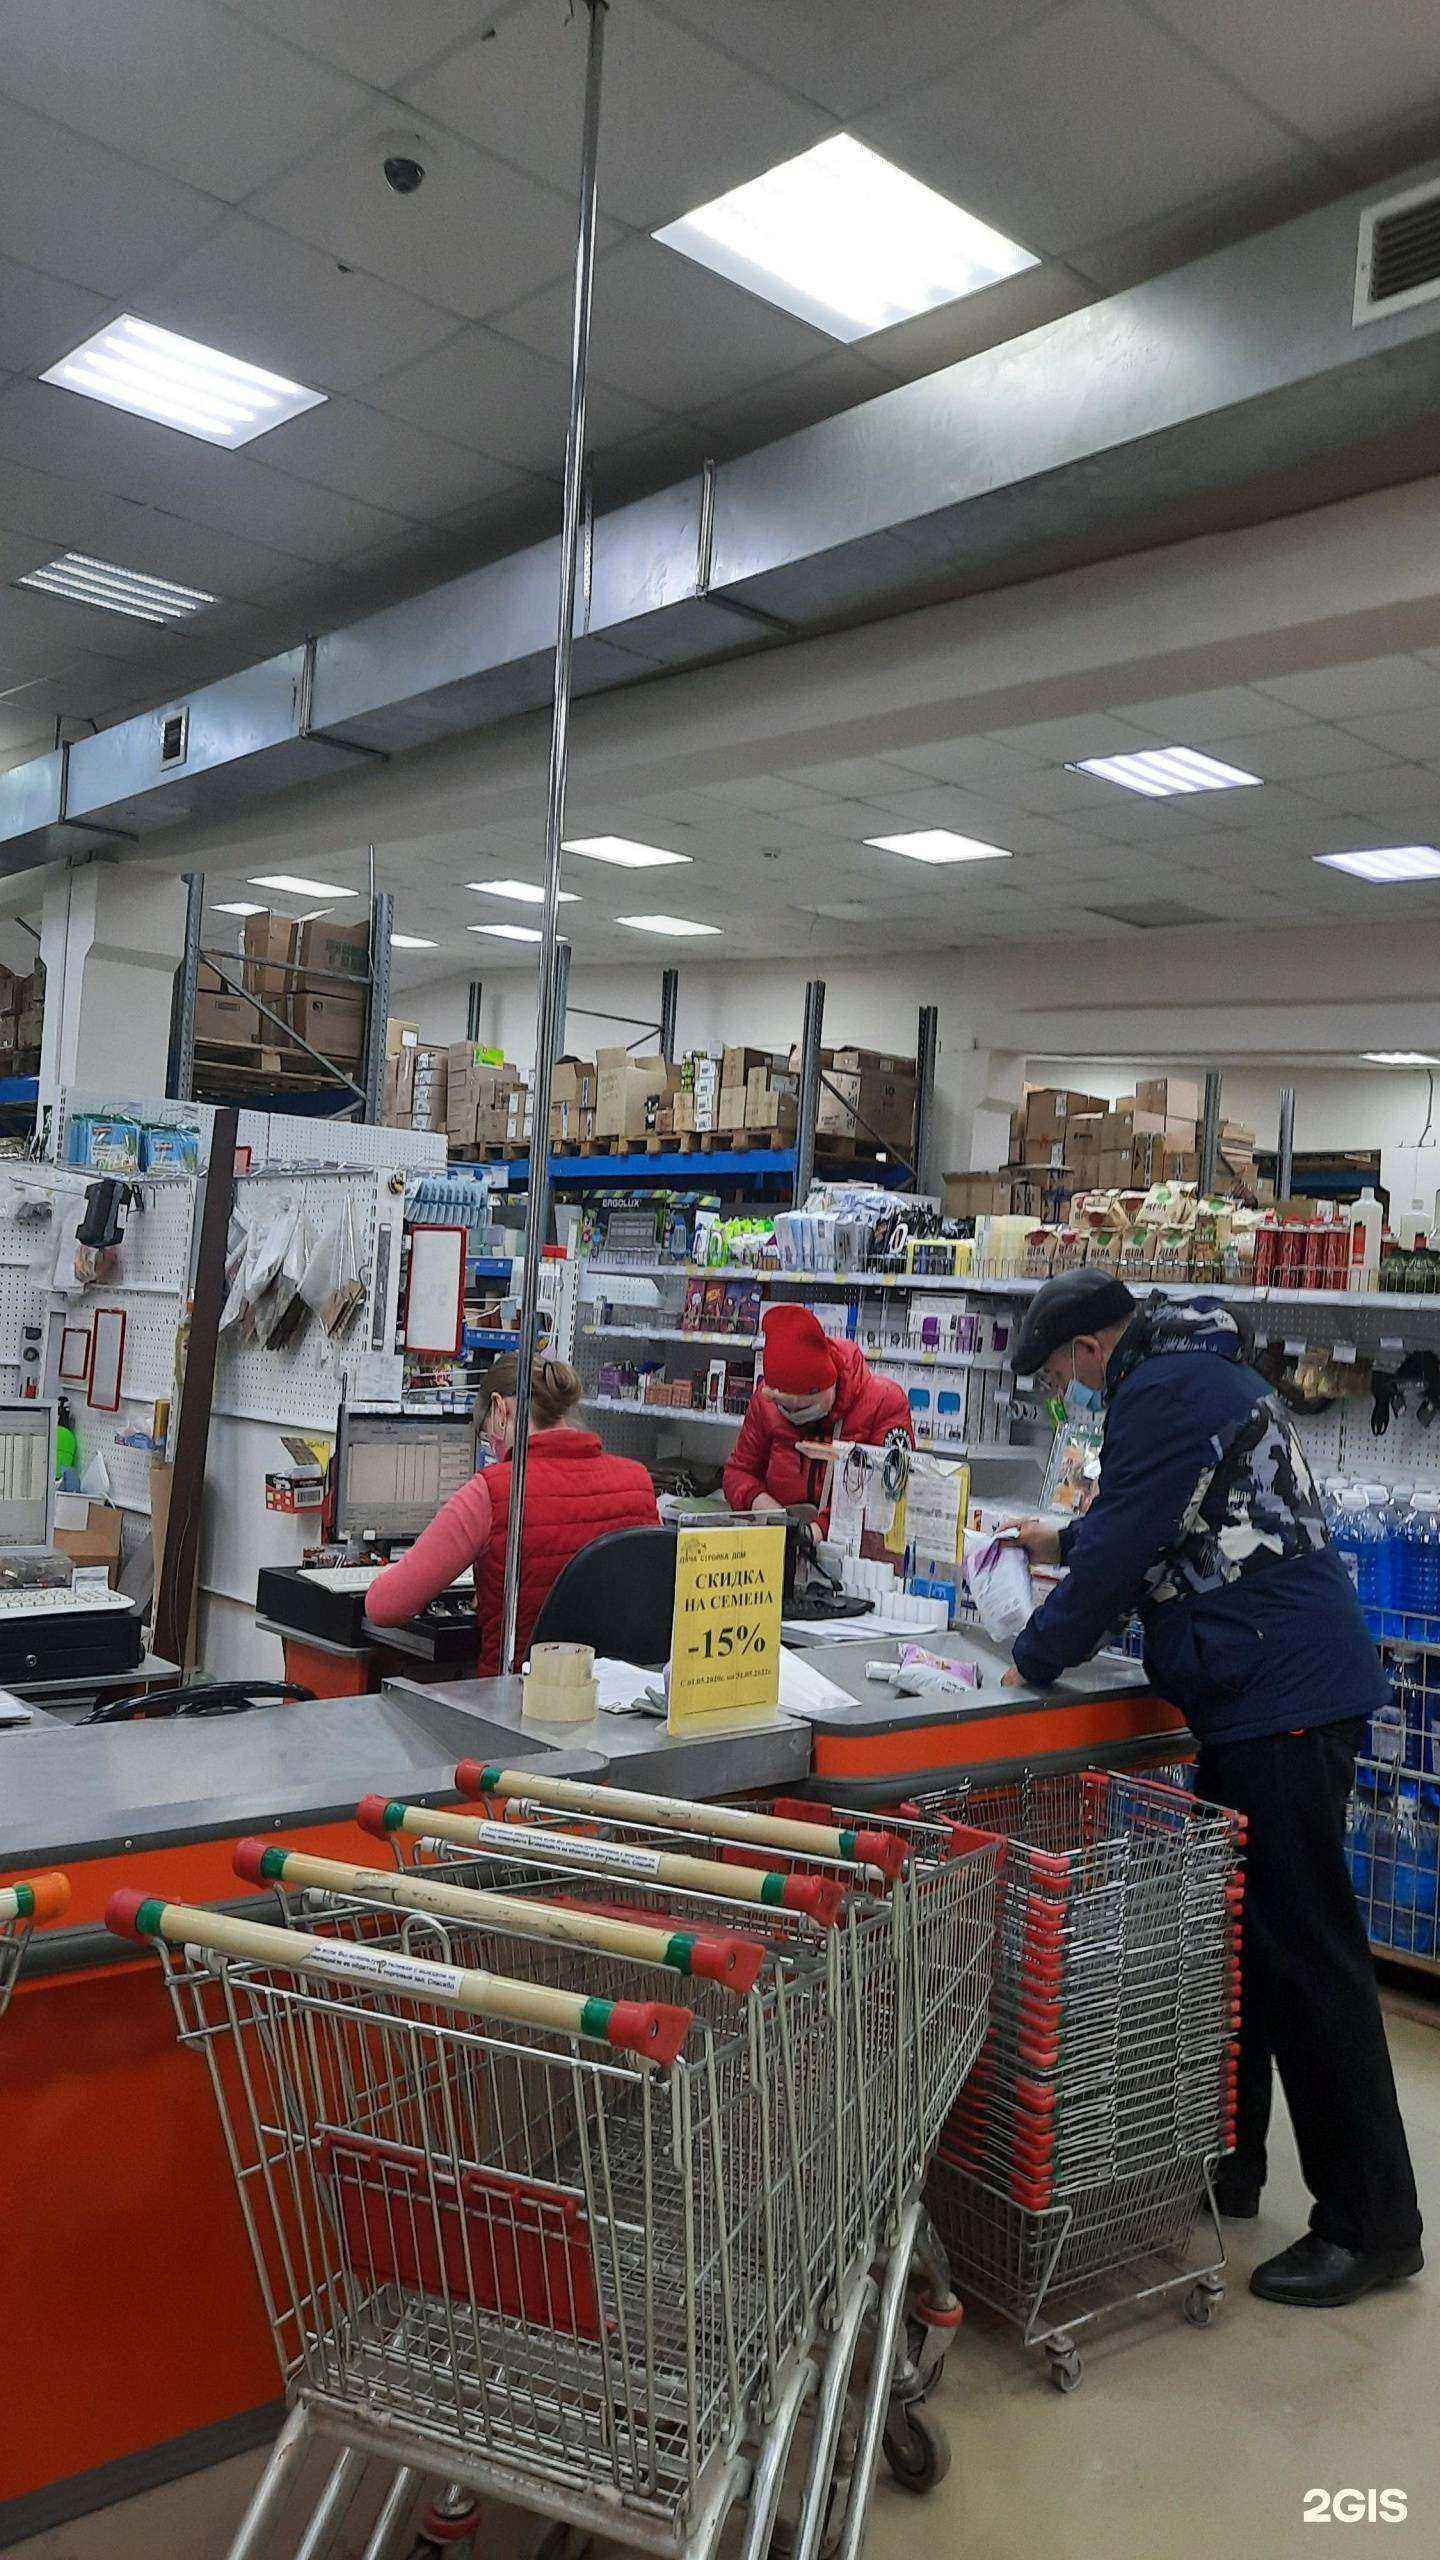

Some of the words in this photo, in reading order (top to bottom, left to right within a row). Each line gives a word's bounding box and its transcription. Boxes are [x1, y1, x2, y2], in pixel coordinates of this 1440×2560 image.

[695, 1568, 765, 1589] СКИДКА
[685, 1598, 706, 1612] НА
[710, 1590, 773, 1610] СЕМЕНА
[688, 1622, 766, 1659] -15%
